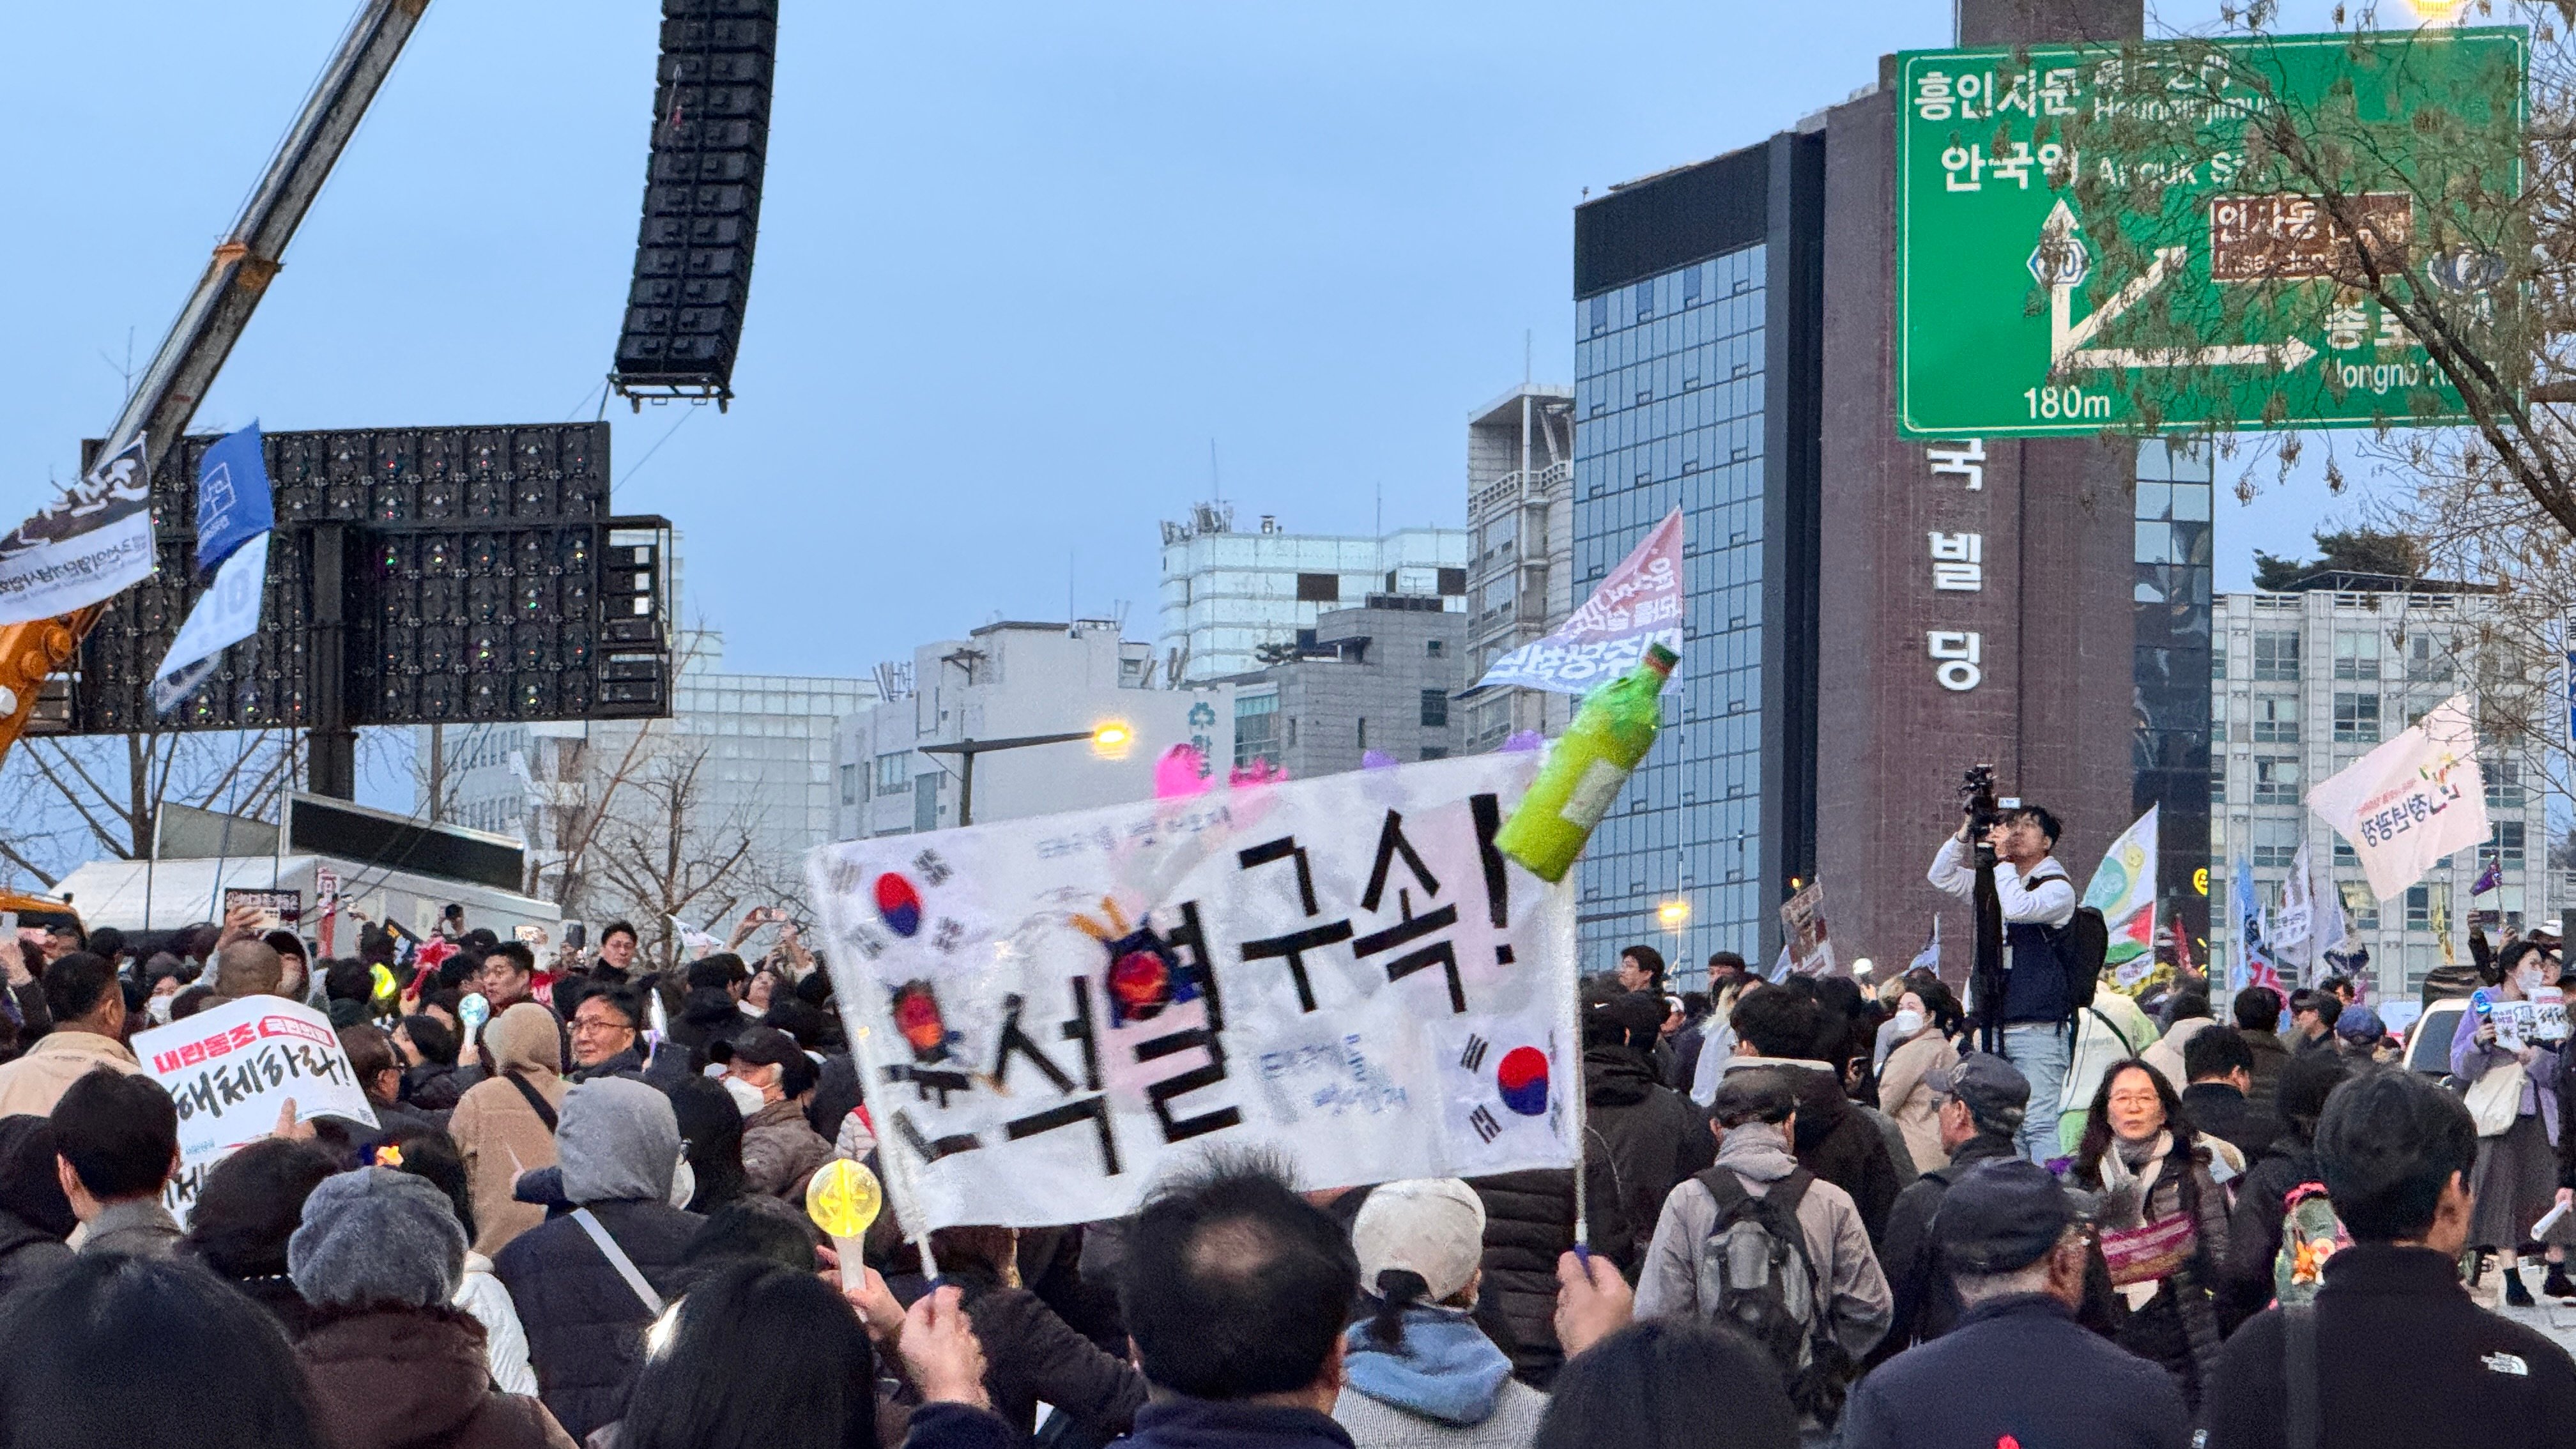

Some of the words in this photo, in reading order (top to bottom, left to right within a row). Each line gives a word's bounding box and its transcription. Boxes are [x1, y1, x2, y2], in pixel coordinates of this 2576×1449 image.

[1914, 68, 2082, 121] 흥인지문
[1941, 142, 2079, 192] 안국역
[2024, 385, 2110, 419] 180m
[1238, 792, 1515, 1015] 구속!
[153, 1022, 257, 1075] 내란동조
[171, 1044, 350, 1121] 해체하라!
